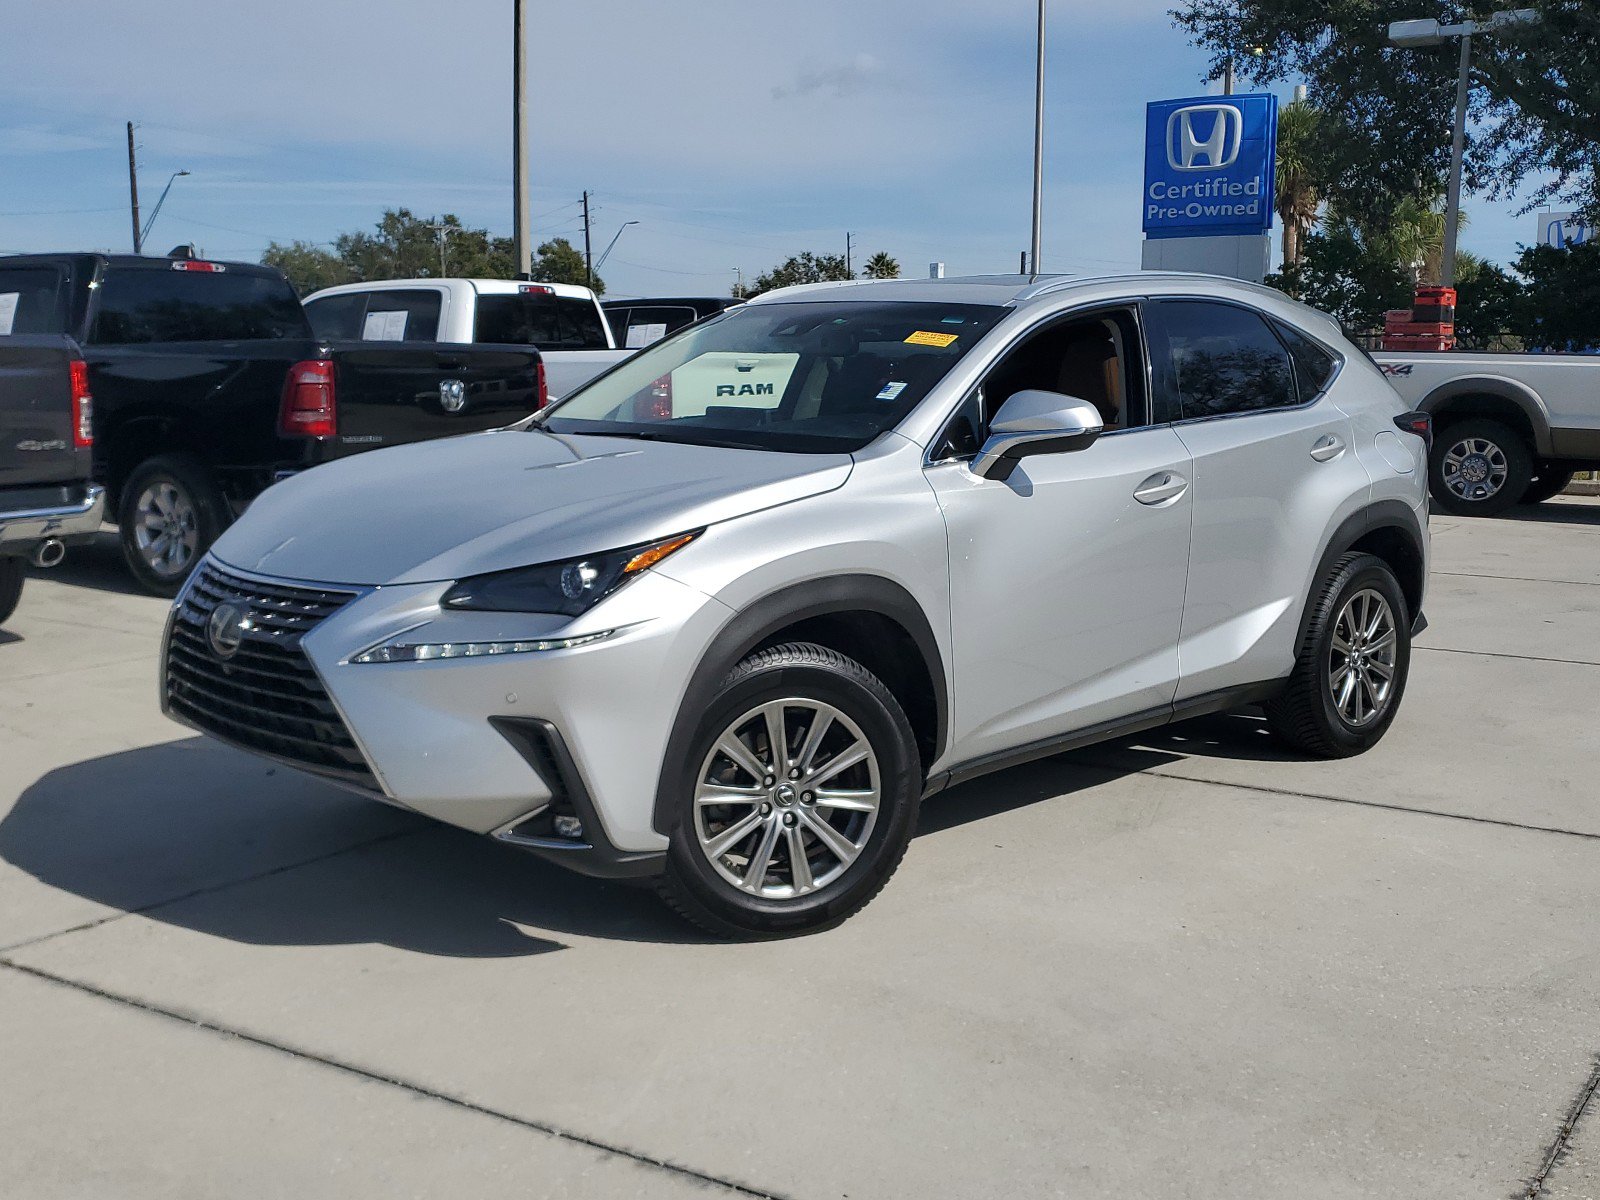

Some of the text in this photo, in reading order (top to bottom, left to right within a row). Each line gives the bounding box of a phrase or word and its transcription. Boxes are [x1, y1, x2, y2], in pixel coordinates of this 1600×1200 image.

[1149, 175, 1260, 200] Certified
[1146, 199, 1259, 219] Pre-Owned
[1379, 363, 1414, 376] X4
[716, 383, 774, 397] RAM
